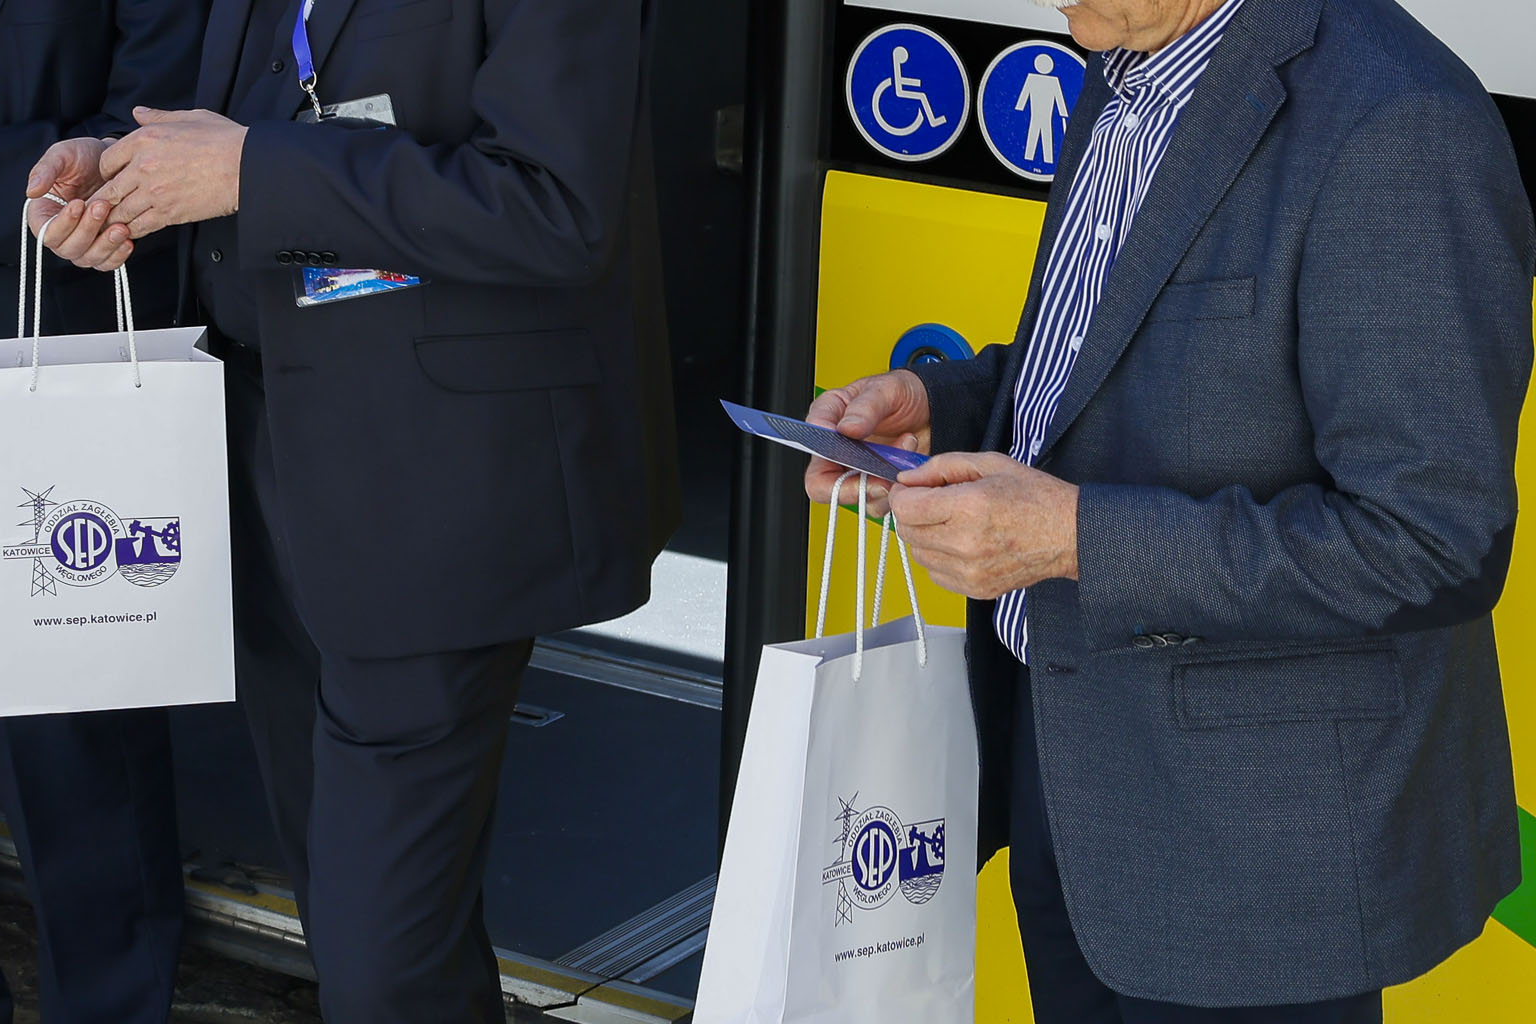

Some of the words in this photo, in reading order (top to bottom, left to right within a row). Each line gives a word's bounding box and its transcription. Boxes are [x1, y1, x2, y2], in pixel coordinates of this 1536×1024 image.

[44, 503, 79, 533] ODDZIAŁ
[81, 503, 120, 536] ZAGŁĘBIA
[3, 546, 51, 557] KATOWICE
[57, 518, 107, 569] SEP
[55, 564, 107, 582] WĘGLOWEGO
[33, 611, 157, 627] www.sep.katowice.pl
[848, 812, 874, 848] ODDZIAŁ
[875, 810, 903, 845] ZAGŁĘBIA
[856, 827, 893, 888] SEP
[822, 864, 852, 881] KATOWICE
[853, 882, 892, 904] WĘGLOWEGO
[835, 932, 926, 963] www.sep.katowice.pl
